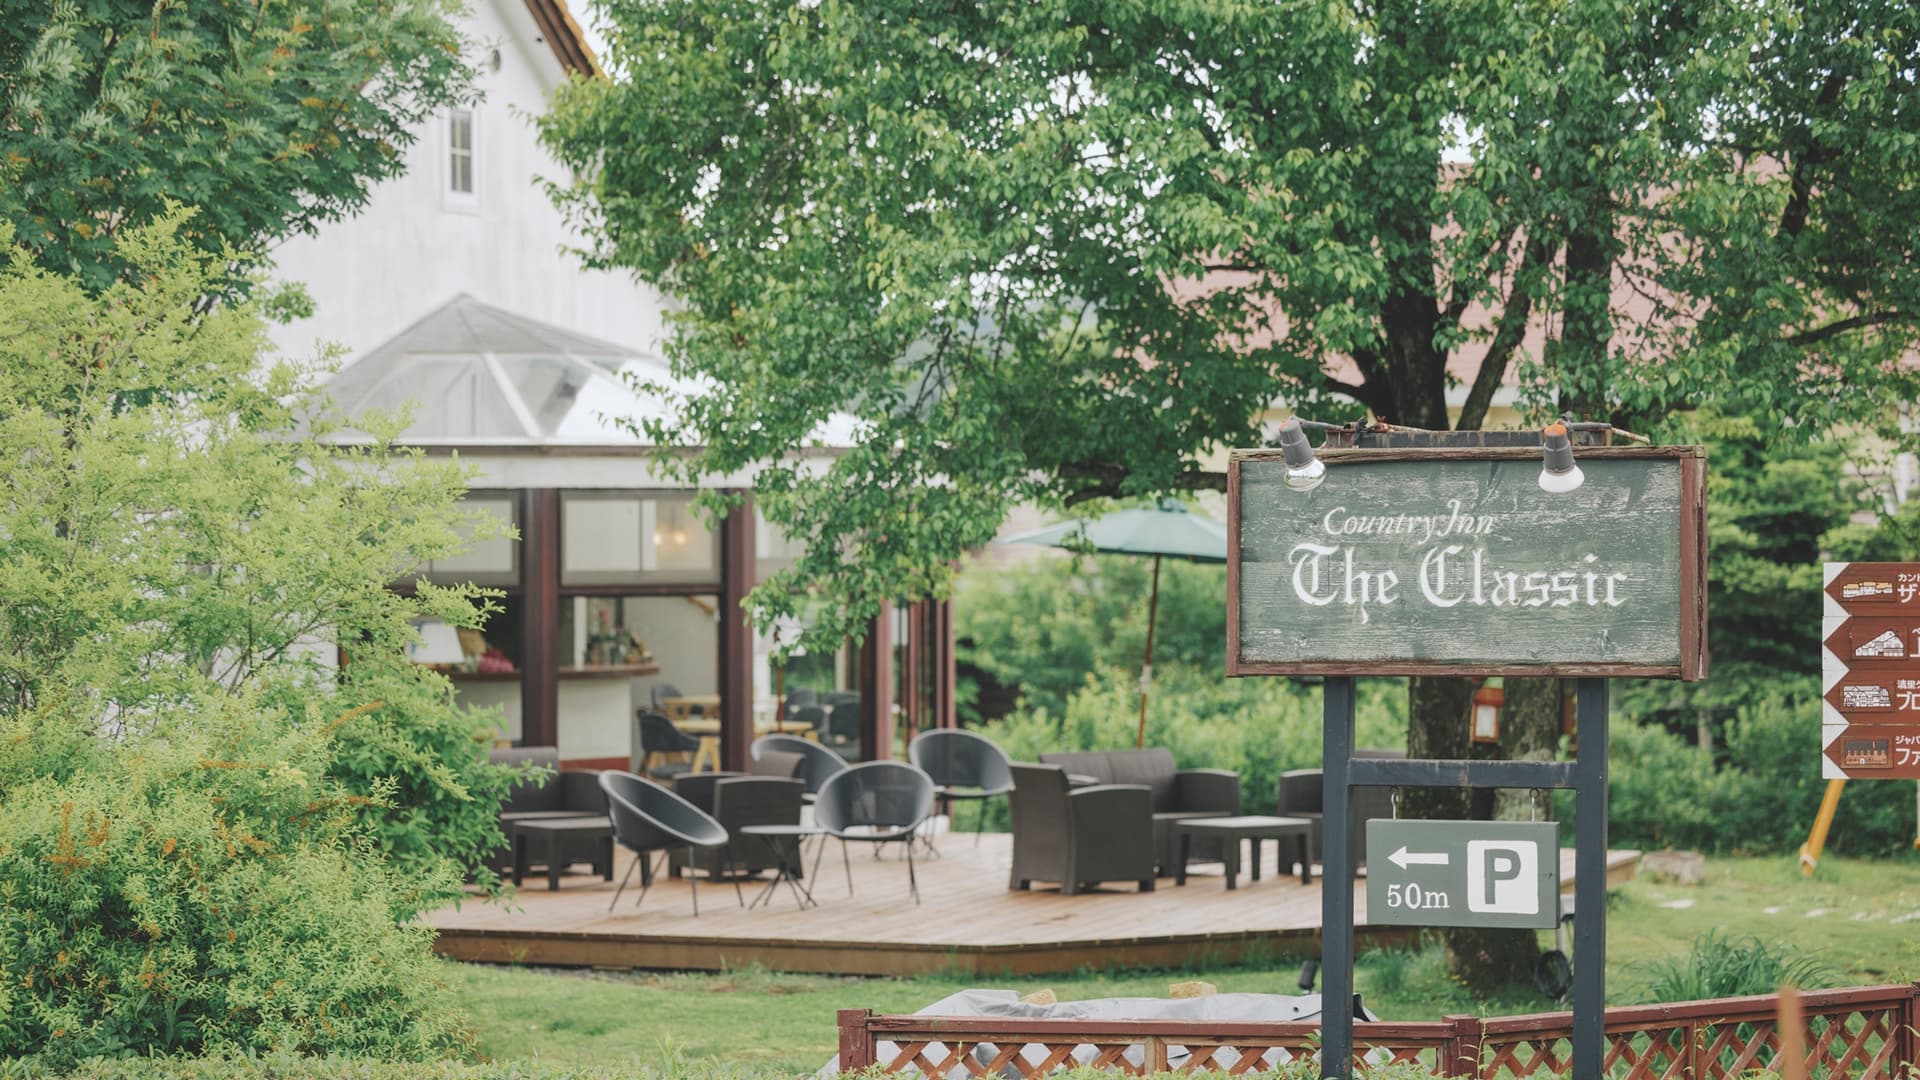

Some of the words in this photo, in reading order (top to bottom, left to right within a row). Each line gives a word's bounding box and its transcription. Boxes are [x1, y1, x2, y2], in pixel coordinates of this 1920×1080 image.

[1323, 505, 1438, 544] Country
[1437, 499, 1495, 536] Inn
[1288, 542, 1400, 624] The
[1418, 545, 1629, 609] Classic
[1386, 882, 1451, 910] 50m
[1483, 848, 1522, 905] P
